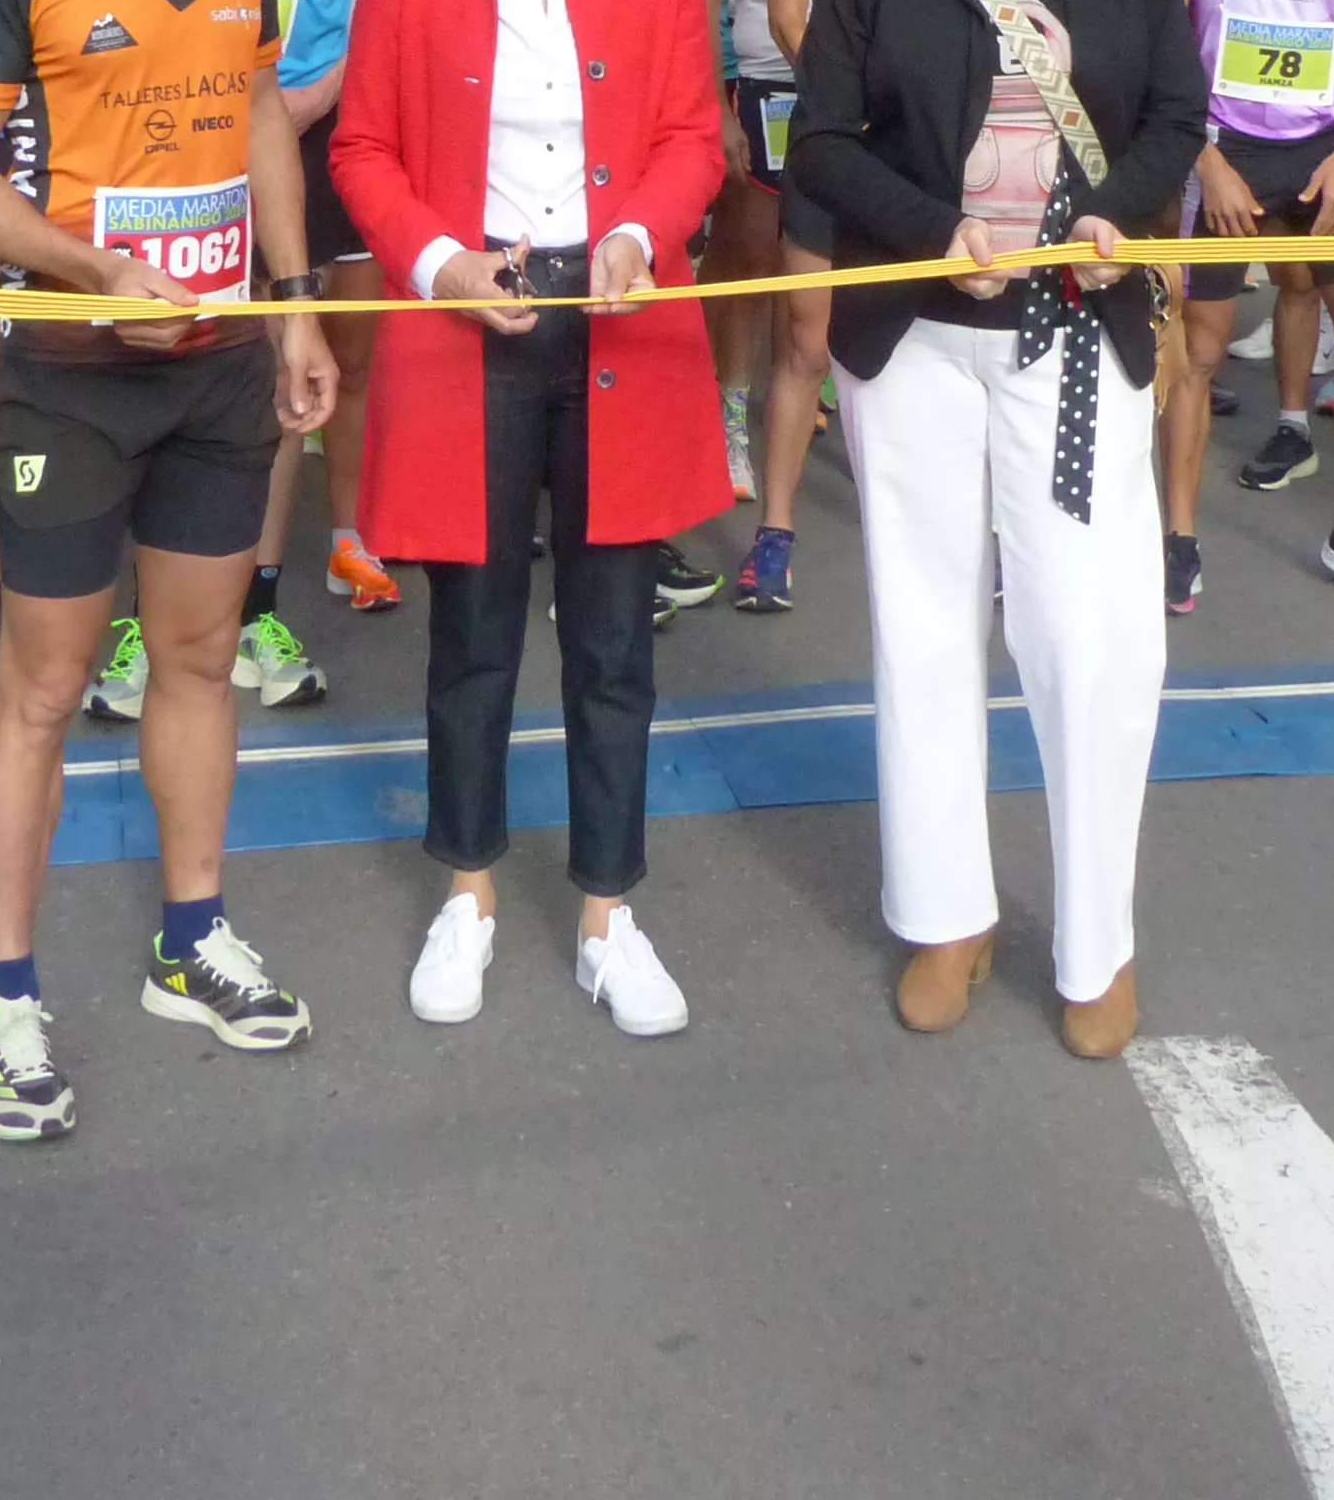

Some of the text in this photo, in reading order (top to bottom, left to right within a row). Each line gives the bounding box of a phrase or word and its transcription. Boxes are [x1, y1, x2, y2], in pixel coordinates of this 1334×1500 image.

[1228, 20, 1334, 41] MEDIA MARATON
[1258, 48, 1303, 78] 78
[1259, 77, 1293, 88] HAMZA
[100, 83, 181, 109] TALLERES
[192, 115, 234, 133] IVECO
[144, 142, 181, 155] OPEL
[107, 187, 248, 218] MEDIA MARATON
[141, 226, 241, 279] 1062
